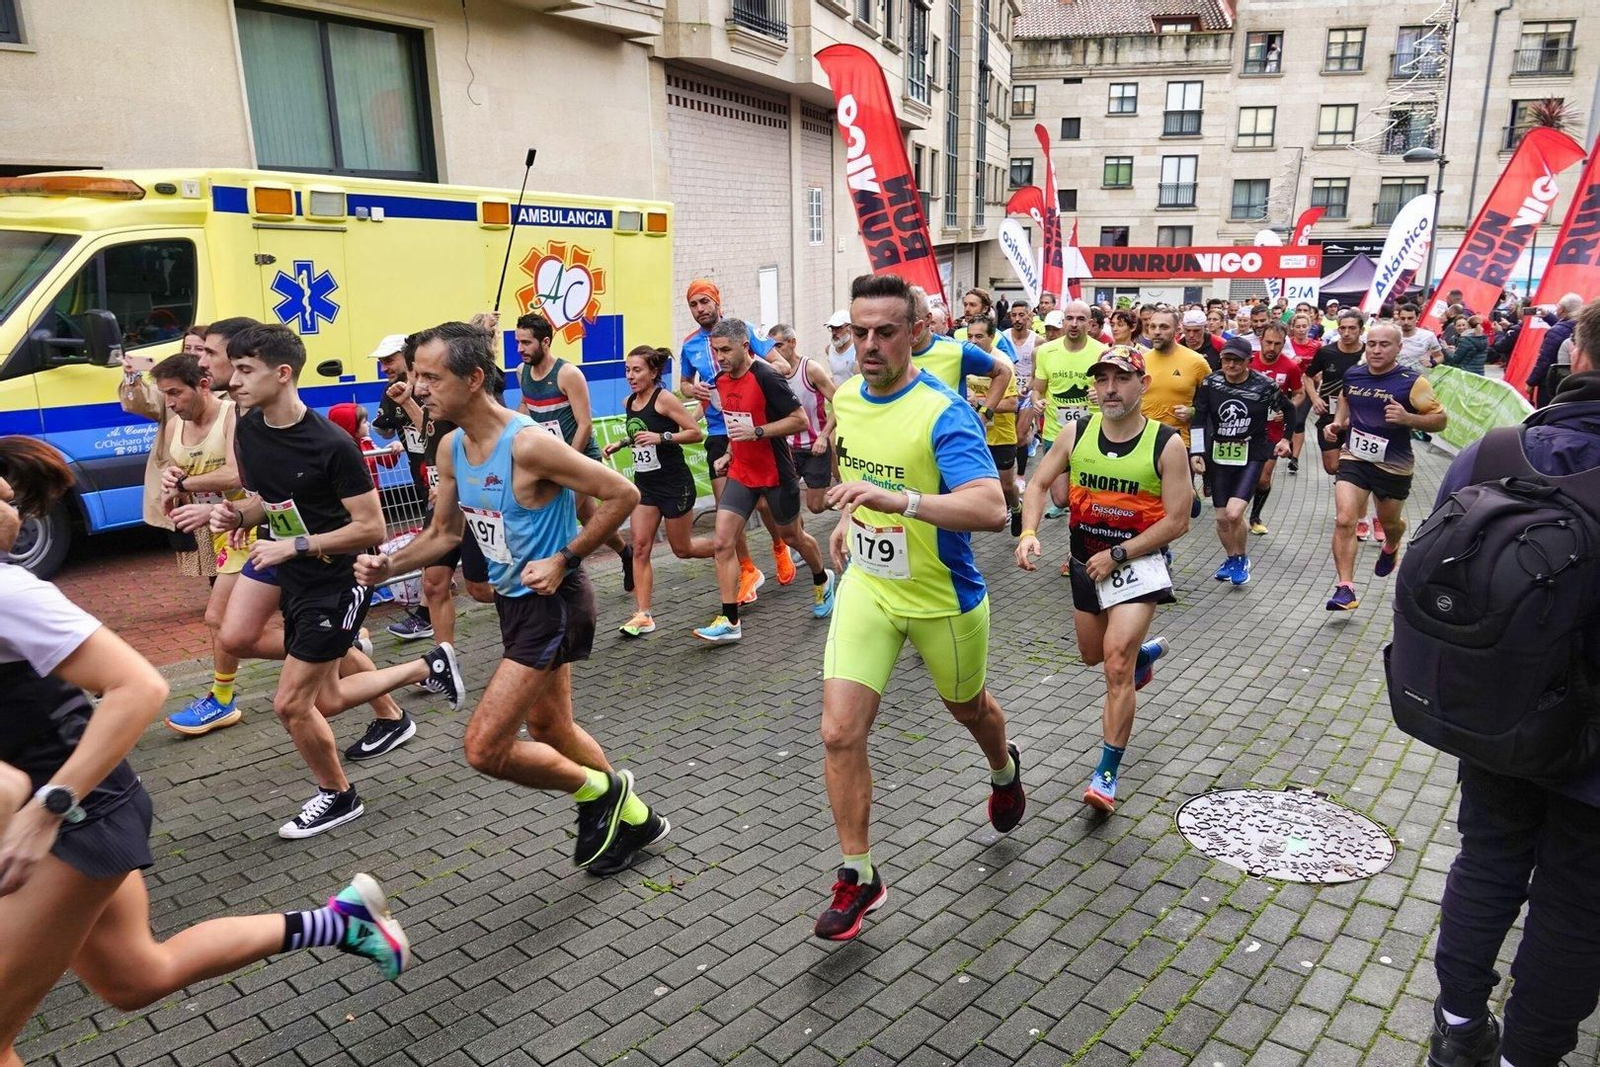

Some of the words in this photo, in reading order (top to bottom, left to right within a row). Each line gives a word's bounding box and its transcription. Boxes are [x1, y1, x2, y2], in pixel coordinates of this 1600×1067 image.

[518, 208, 607, 226] AMBULANCIA
[1480, 174, 1561, 289] RUNVIG
[1454, 209, 1512, 280] RUN
[1374, 217, 1428, 298] Atlántico
[1065, 411, 1081, 421] 66
[127, 446, 142, 454] 981
[1218, 446, 1242, 457] 515
[1355, 437, 1380, 454] 138
[845, 455, 905, 479] DEPORTE
[1079, 471, 1140, 496] 3NORTH
[468, 518, 496, 546] 197
[856, 532, 895, 563] 179
[1110, 564, 1139, 588] 82
